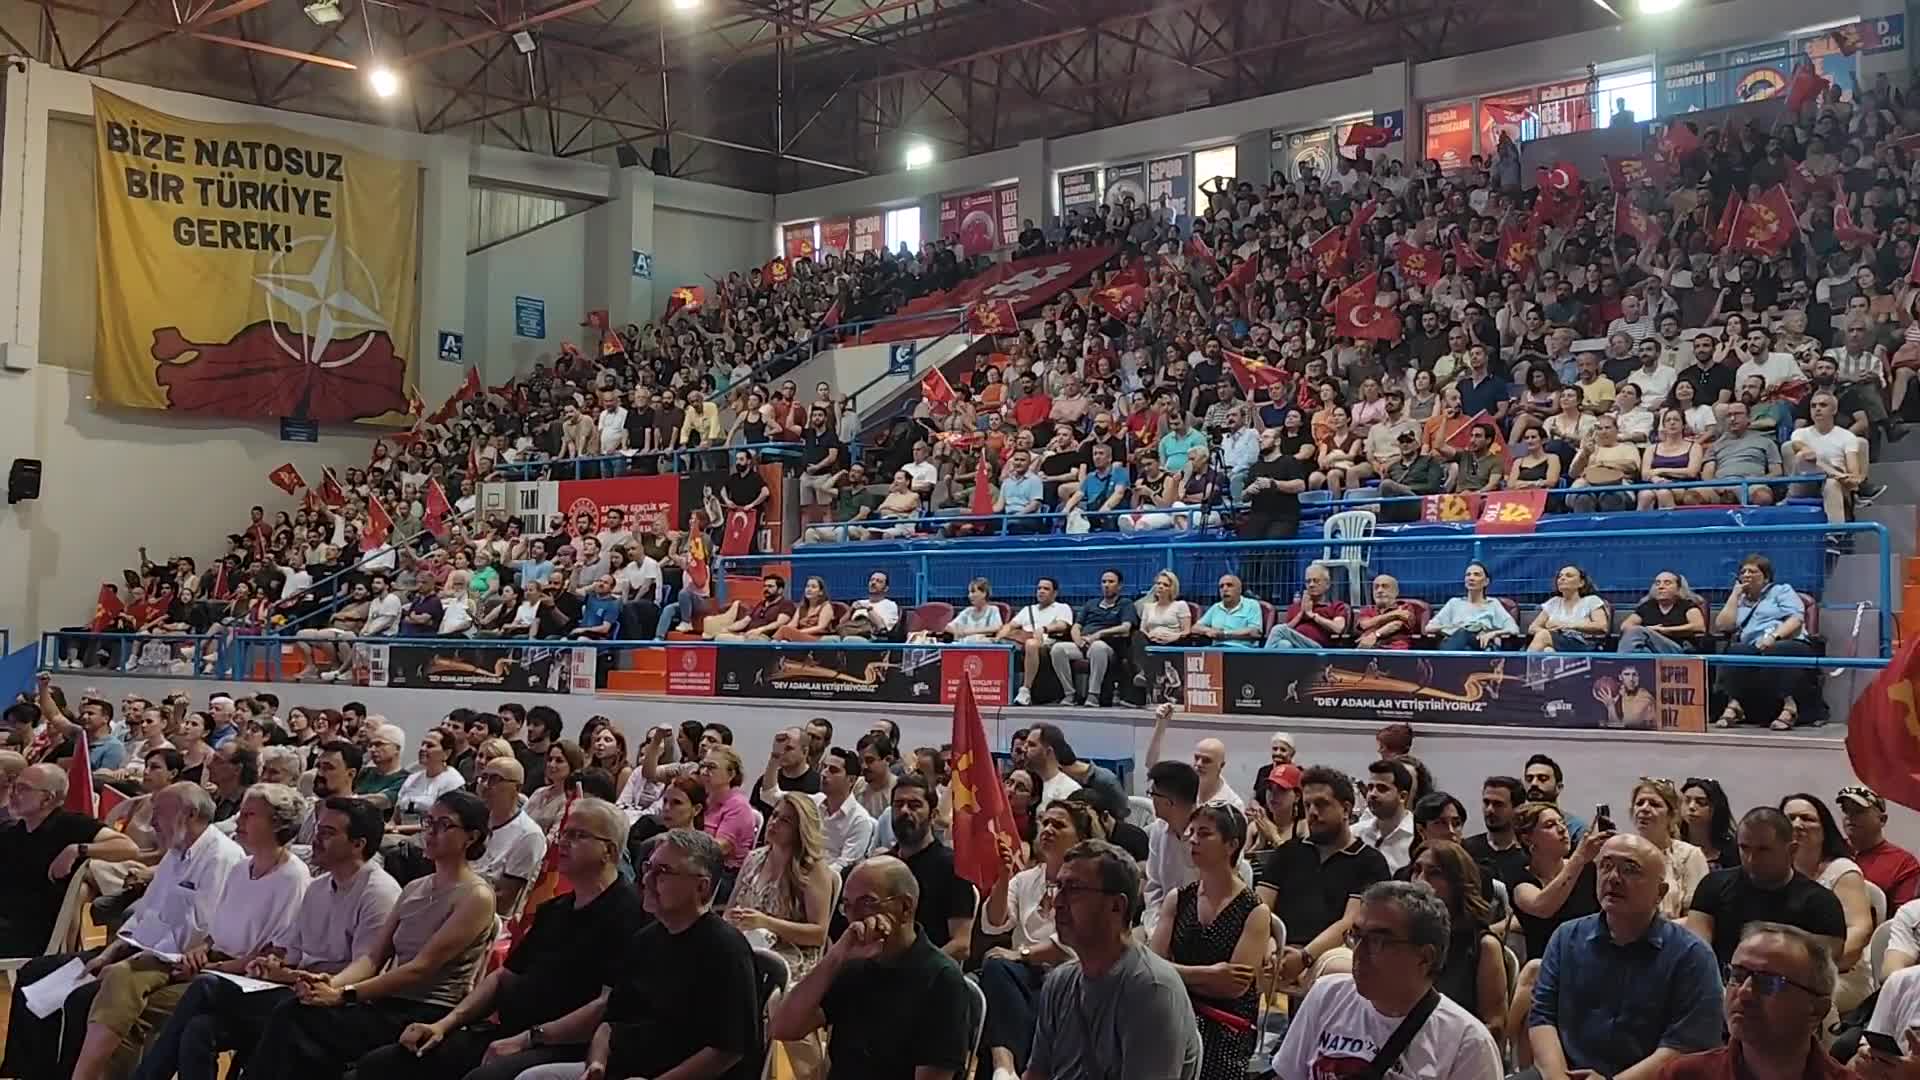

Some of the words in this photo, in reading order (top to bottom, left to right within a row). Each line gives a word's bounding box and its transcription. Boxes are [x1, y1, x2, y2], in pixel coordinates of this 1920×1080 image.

[106, 119, 185, 165] BİZE
[194, 139, 344, 182] NATOSUZ
[125, 163, 185, 205] BİR
[192, 171, 332, 219] TÜRKİYE
[172, 216, 293, 253] GEREK!
[1313, 697, 1339, 707] "DEV
[1341, 698, 1393, 709] ADAMLAR
[1394, 698, 1488, 713] YETİŞTİRİYORUZ"
